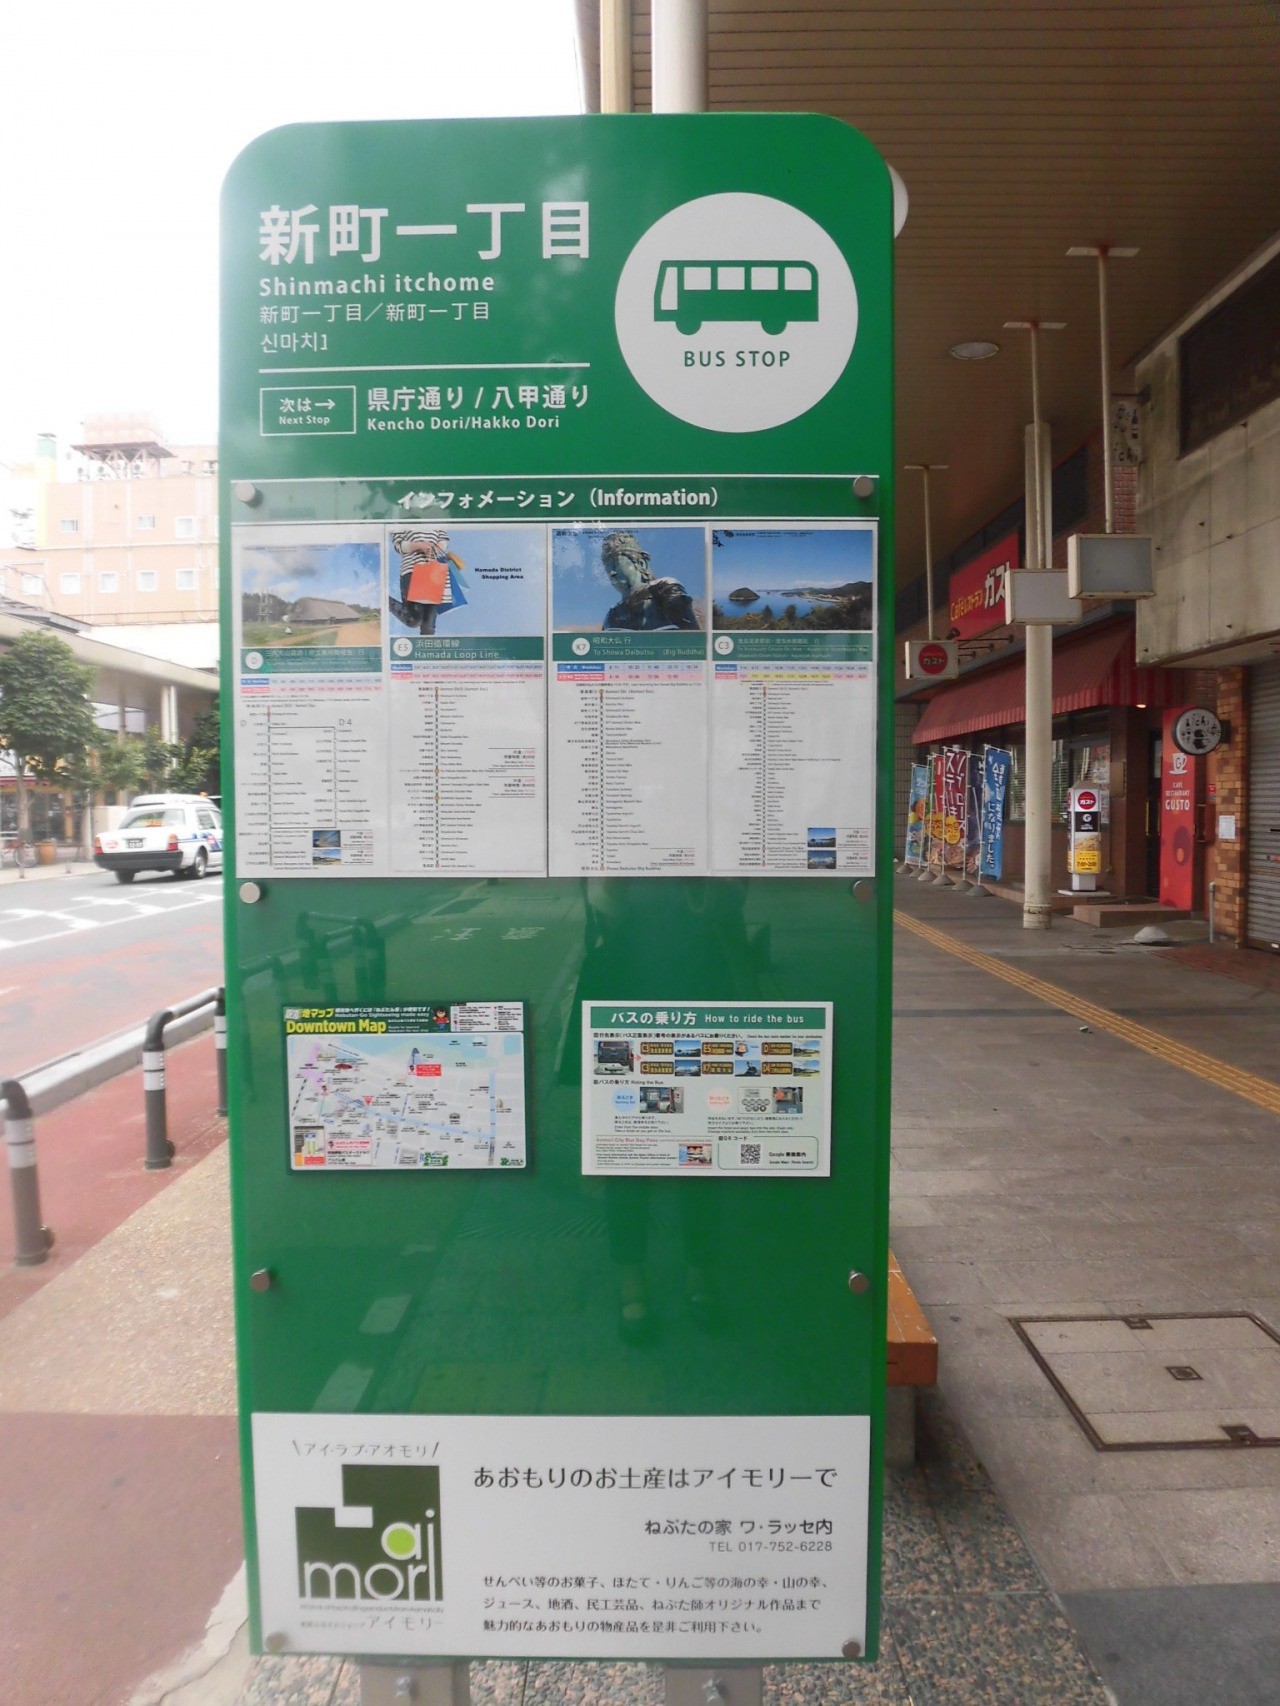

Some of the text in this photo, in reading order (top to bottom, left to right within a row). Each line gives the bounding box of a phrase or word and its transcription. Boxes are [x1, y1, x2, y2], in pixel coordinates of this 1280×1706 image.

[259, 201, 590, 265] 新町一丁目
[259, 272, 495, 297] Shinmachi itchome
[683, 351, 791, 367] BUS STOP
[279, 398, 312, 412] 次は
[368, 387, 463, 412] 県庁通り
[491, 384, 590, 410] 八甲通り
[279, 415, 330, 426] Next Stop
[367, 417, 426, 431] Kencho
[526, 415, 560, 428] Dori
[398, 490, 575, 509] インフォメーション
[718, 641, 730, 650] C3
[415, 651, 500, 660] Hamada Loop Line
[1165, 799, 1190, 811] GUSTO
[611, 1011, 698, 1026] バスの乗り方
[705, 1014, 805, 1024] How to ride the bus
[286, 1020, 356, 1033] Downtown
[359, 1019, 387, 1034] Map
[473, 1466, 839, 1490] あおもりのお土産はアイモリーで
[645, 1518, 833, 1536] ねぶたの家 ワ・ラッセ内
[709, 1540, 833, 1553] TEL 017-752-6228
[483, 1619, 763, 1634] 魅力的なあおもりの物産品を是非ご利用下さい。
